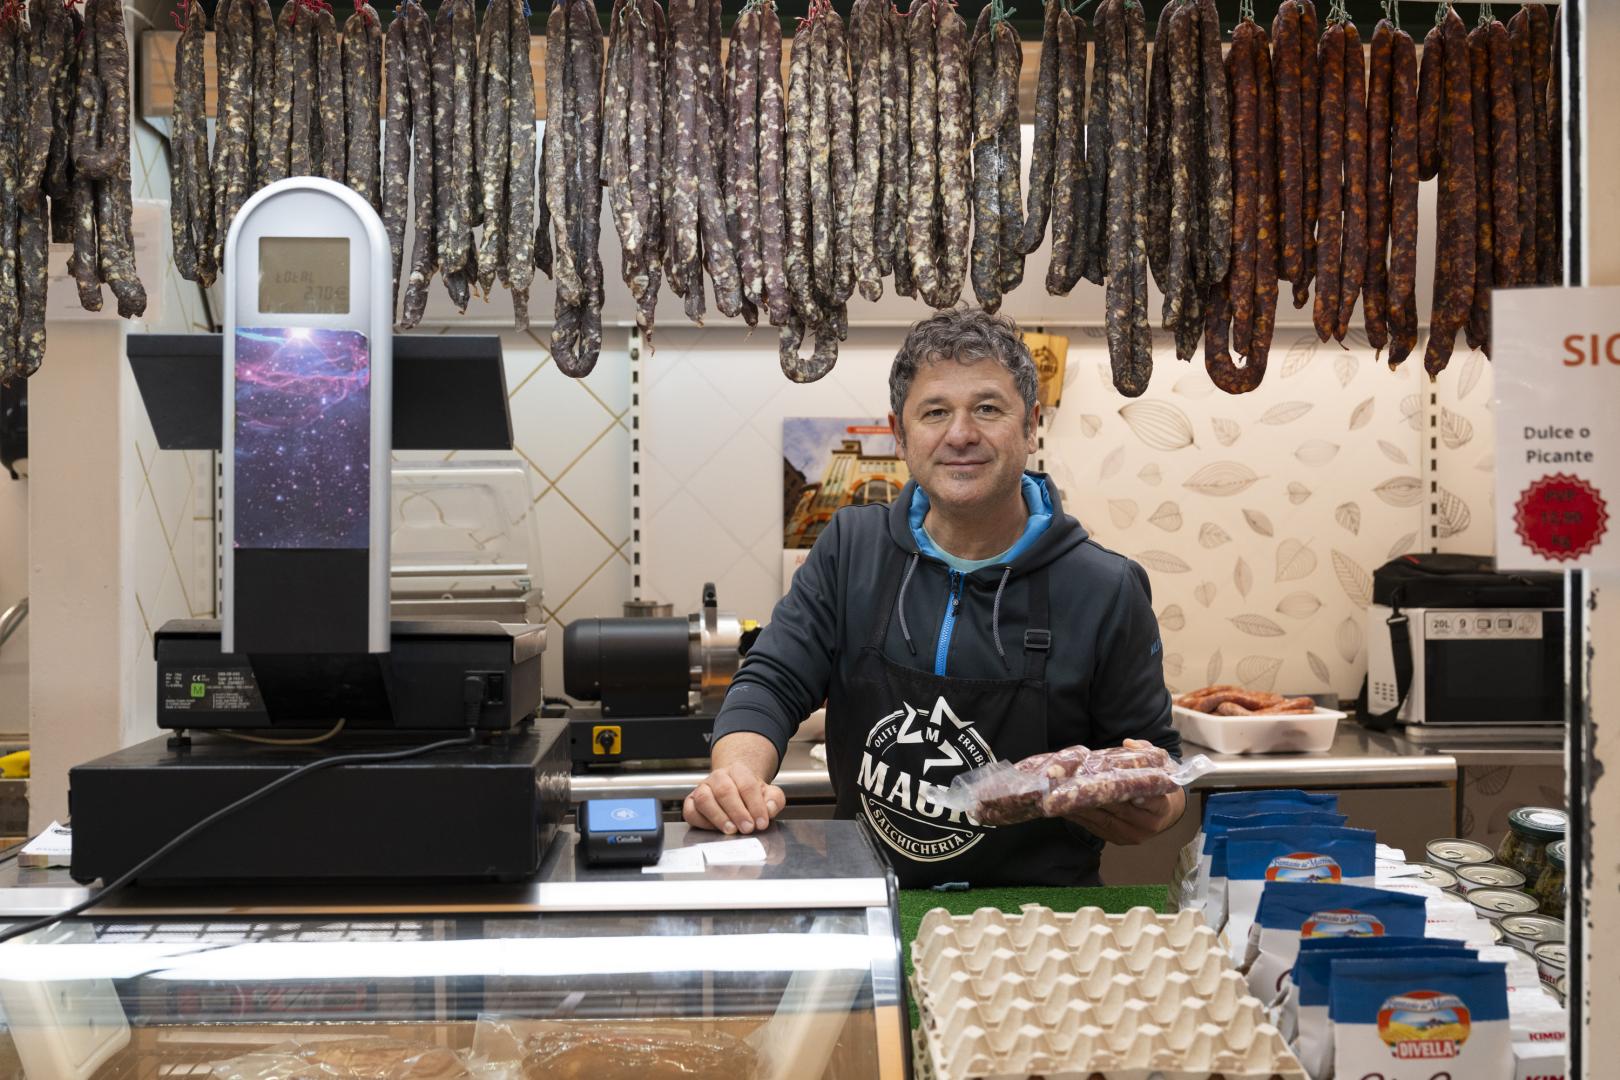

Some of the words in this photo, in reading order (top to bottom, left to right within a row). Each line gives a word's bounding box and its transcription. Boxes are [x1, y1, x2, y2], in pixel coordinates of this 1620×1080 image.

[1524, 425, 1574, 439] Dulce
[1579, 427, 1590, 438] o
[1526, 449, 1593, 463] Picante
[925, 726, 940, 743] M
[873, 809, 964, 854] SALCHICHERIA
[1400, 1041, 1454, 1057] DIVELLA
